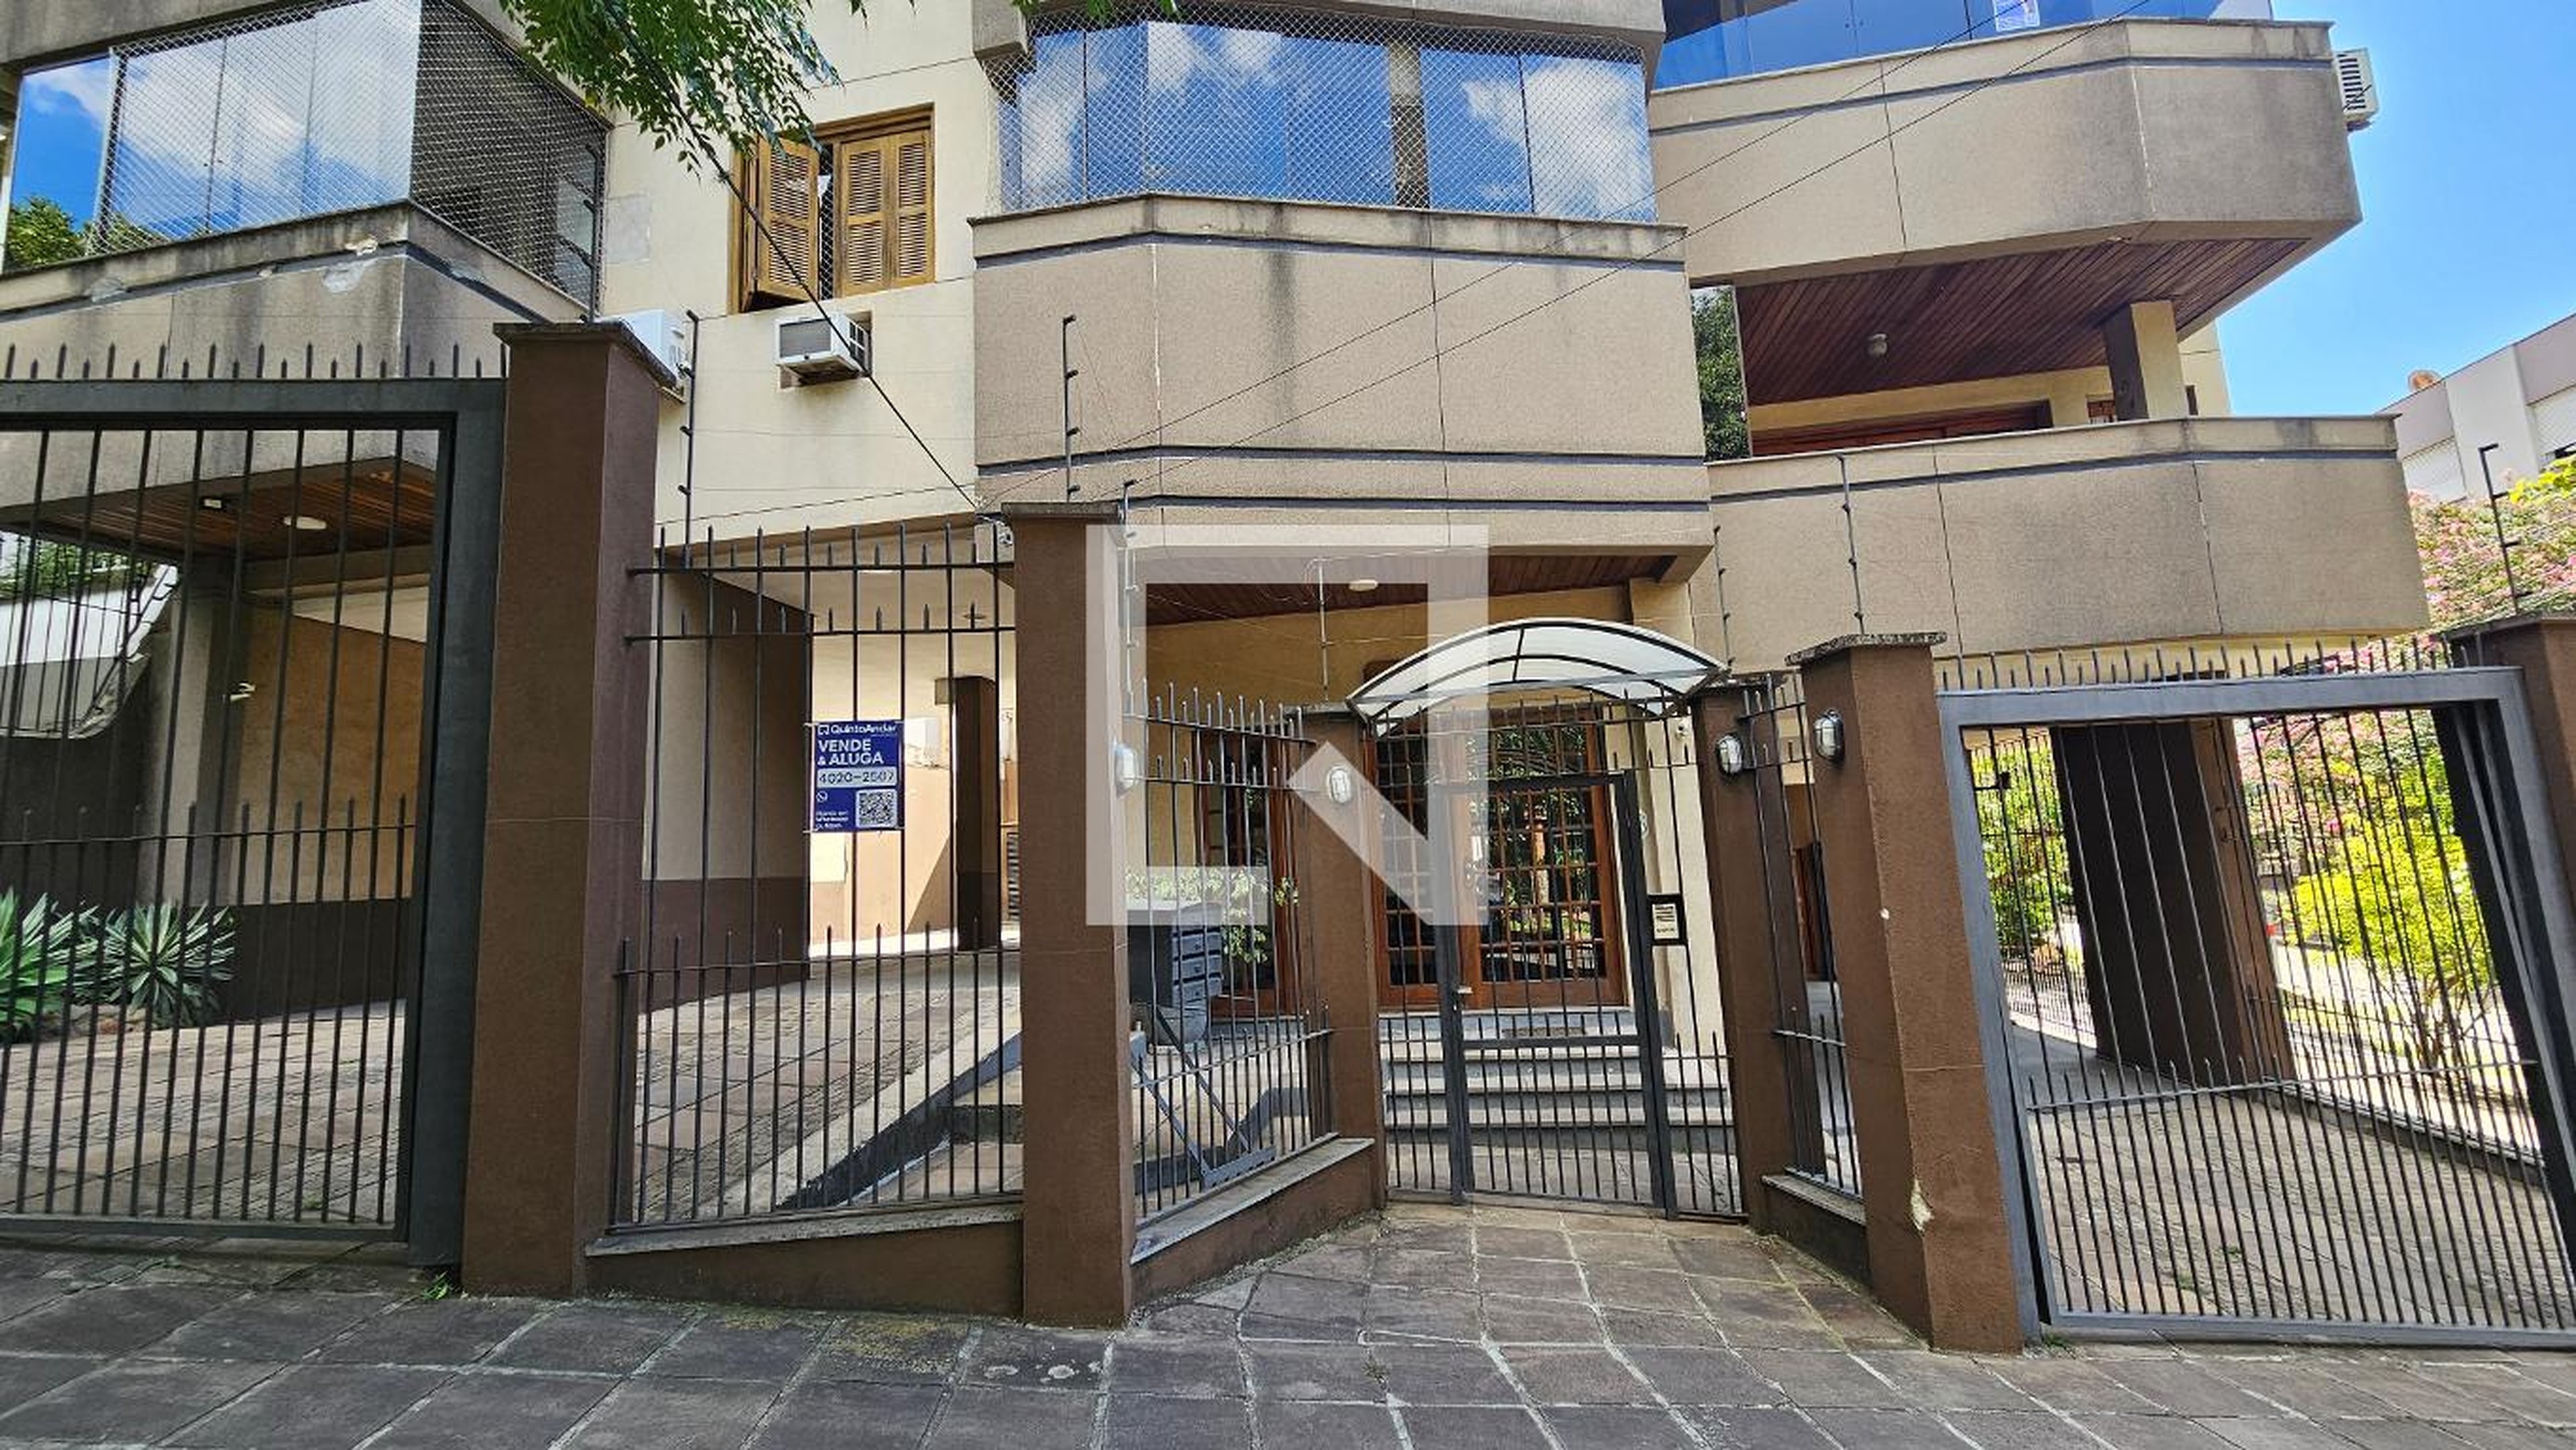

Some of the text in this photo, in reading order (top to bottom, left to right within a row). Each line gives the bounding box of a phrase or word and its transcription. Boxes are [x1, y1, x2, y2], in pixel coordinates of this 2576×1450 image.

[830, 724, 896, 734] QuintoAndar
[818, 738, 871, 752] VENDE
[828, 752, 884, 765] ALUGA
